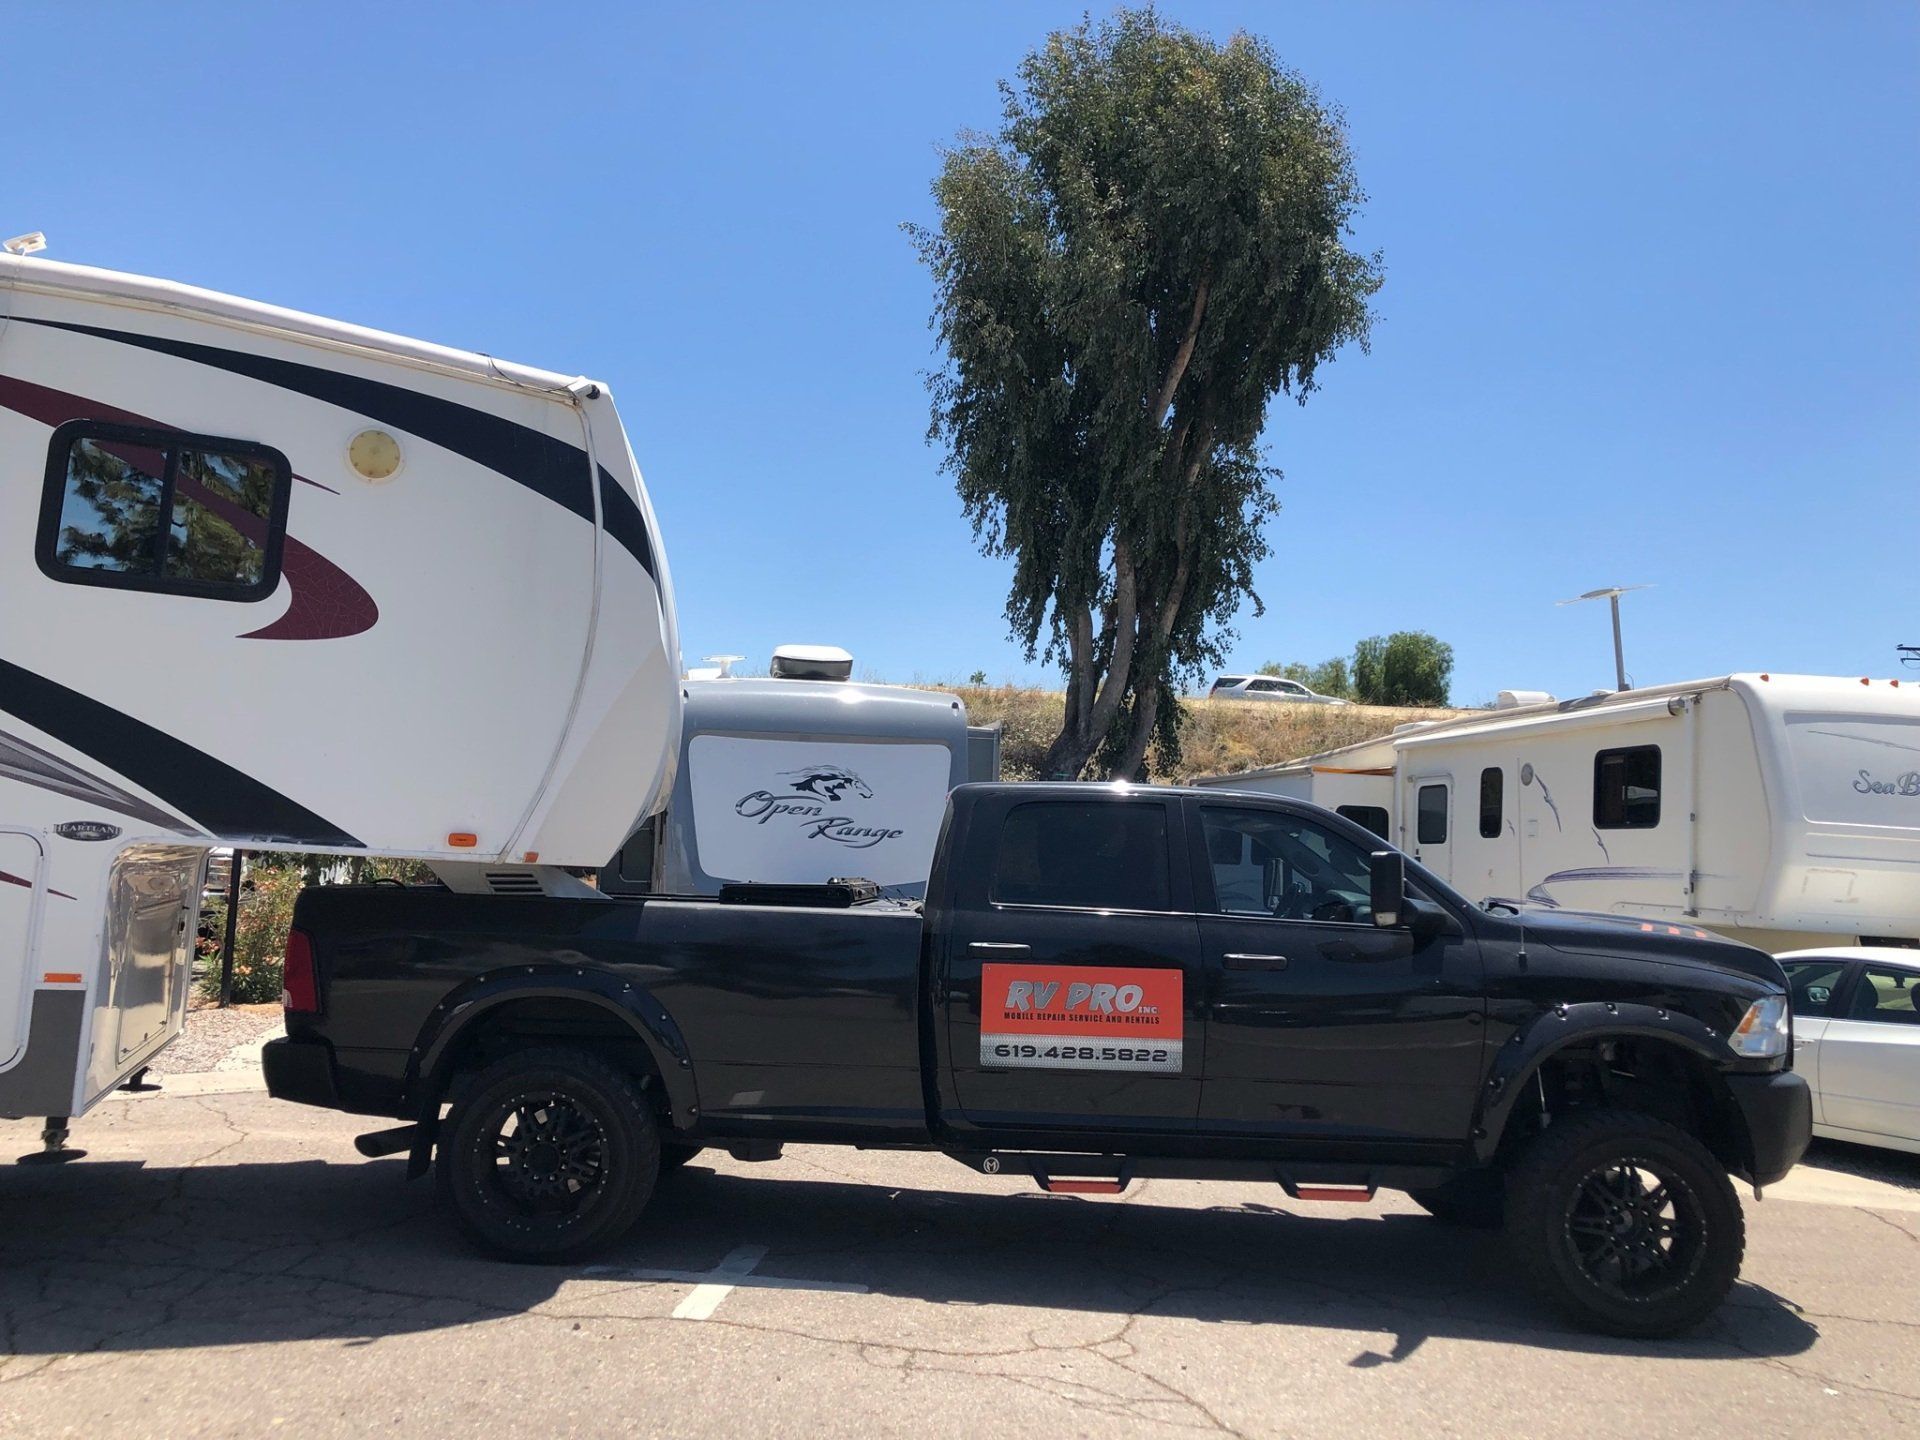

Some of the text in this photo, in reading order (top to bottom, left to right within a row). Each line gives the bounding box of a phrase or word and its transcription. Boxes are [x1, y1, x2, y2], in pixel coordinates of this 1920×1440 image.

[1853, 769, 1896, 795] Sea
[734, 790, 826, 824] Open
[800, 817, 904, 849] Range
[1005, 980, 1158, 1014] RV PRO INC
[1003, 1011, 1160, 1024] MOBILE REPAIR SERVICE AND RENTALS
[995, 1044, 1168, 1062] 619.428.5822
